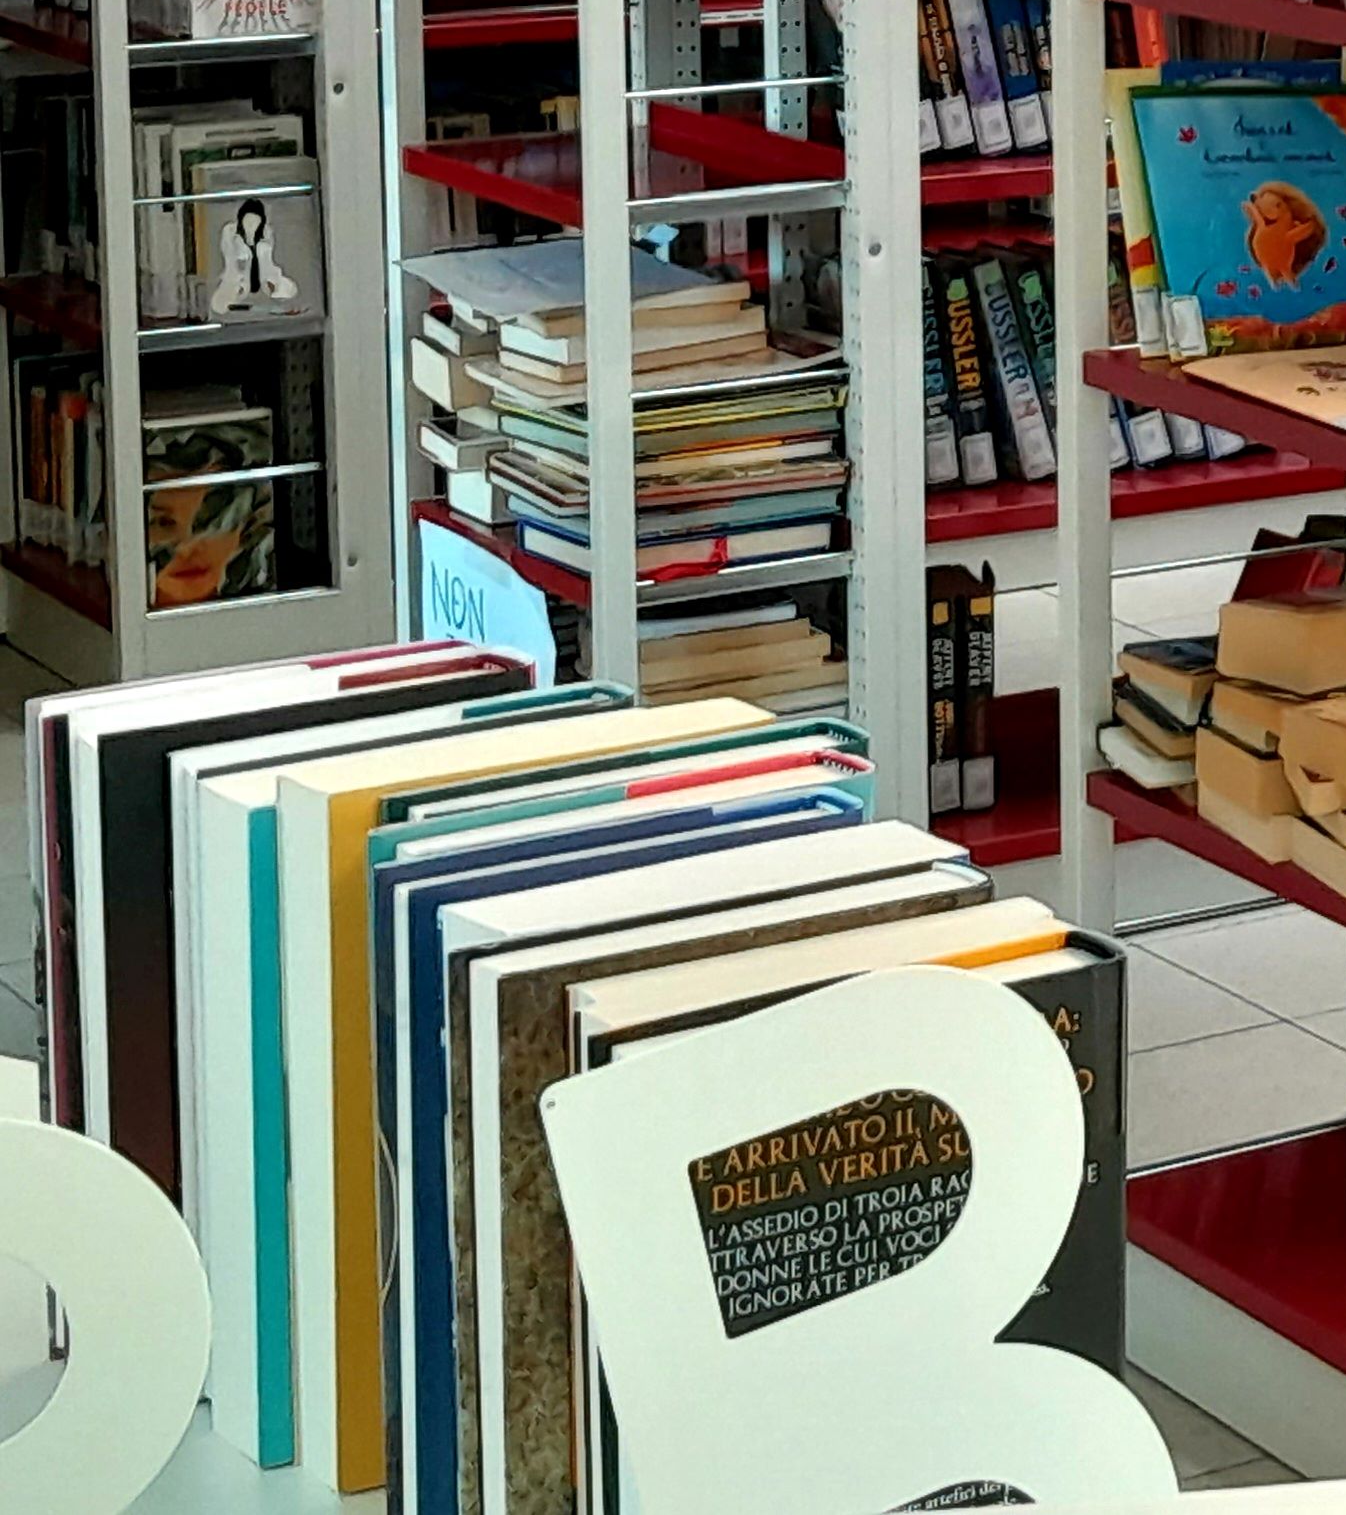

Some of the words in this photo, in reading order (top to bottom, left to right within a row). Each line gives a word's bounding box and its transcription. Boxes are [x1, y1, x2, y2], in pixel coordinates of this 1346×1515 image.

[947, 298, 983, 392] USSLER
[431, 559, 485, 640] NON
[711, 1167, 808, 1215] DELLA
[818, 1135, 932, 1188] VERITÀ
[722, 1113, 888, 1176] ARRIVATO
[892, 1107, 921, 1140] IL
[708, 1204, 820, 1251] L'ASSEDIO
[825, 1198, 849, 1224] DI
[854, 1181, 924, 1217] TROIA
[710, 1223, 840, 1274] TTRAVERSO
[842, 1218, 871, 1244] LA
[877, 1196, 967, 1233] PROSPET
[716, 1254, 804, 1299] DONNE
[806, 1249, 832, 1275] LE
[835, 1240, 880, 1270] CUI
[885, 1228, 942, 1257] VOCI
[726, 1274, 848, 1320] IGNORATE
